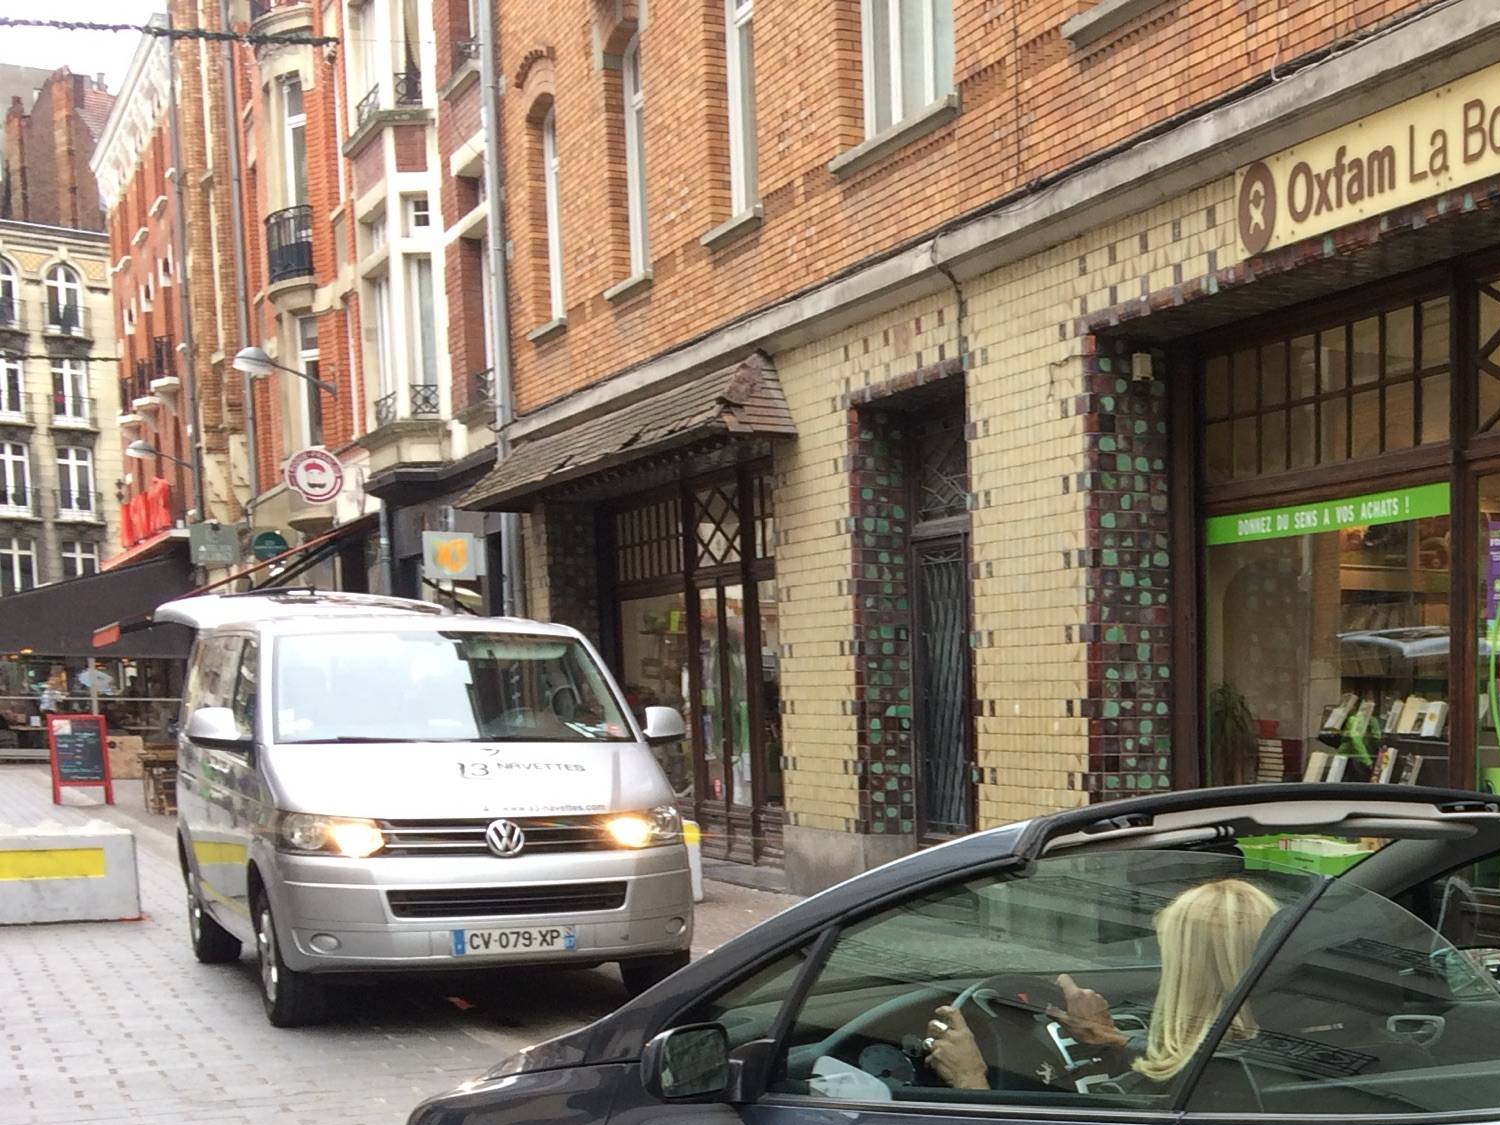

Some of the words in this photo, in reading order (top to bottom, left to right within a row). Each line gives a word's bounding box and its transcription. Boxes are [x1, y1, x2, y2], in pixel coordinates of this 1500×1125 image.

[1287, 144, 1396, 224] Oxfam
[1408, 123, 1449, 184] La
[1237, 515, 1272, 537] DONNEZ
[1276, 513, 1290, 532] DU
[1294, 509, 1318, 529] SENS
[1335, 504, 1356, 524] VOS
[1360, 497, 1400, 521] ACHATS
[497, 761, 587, 772] NAVETTES
[469, 929, 561, 950] CV-079-XP
